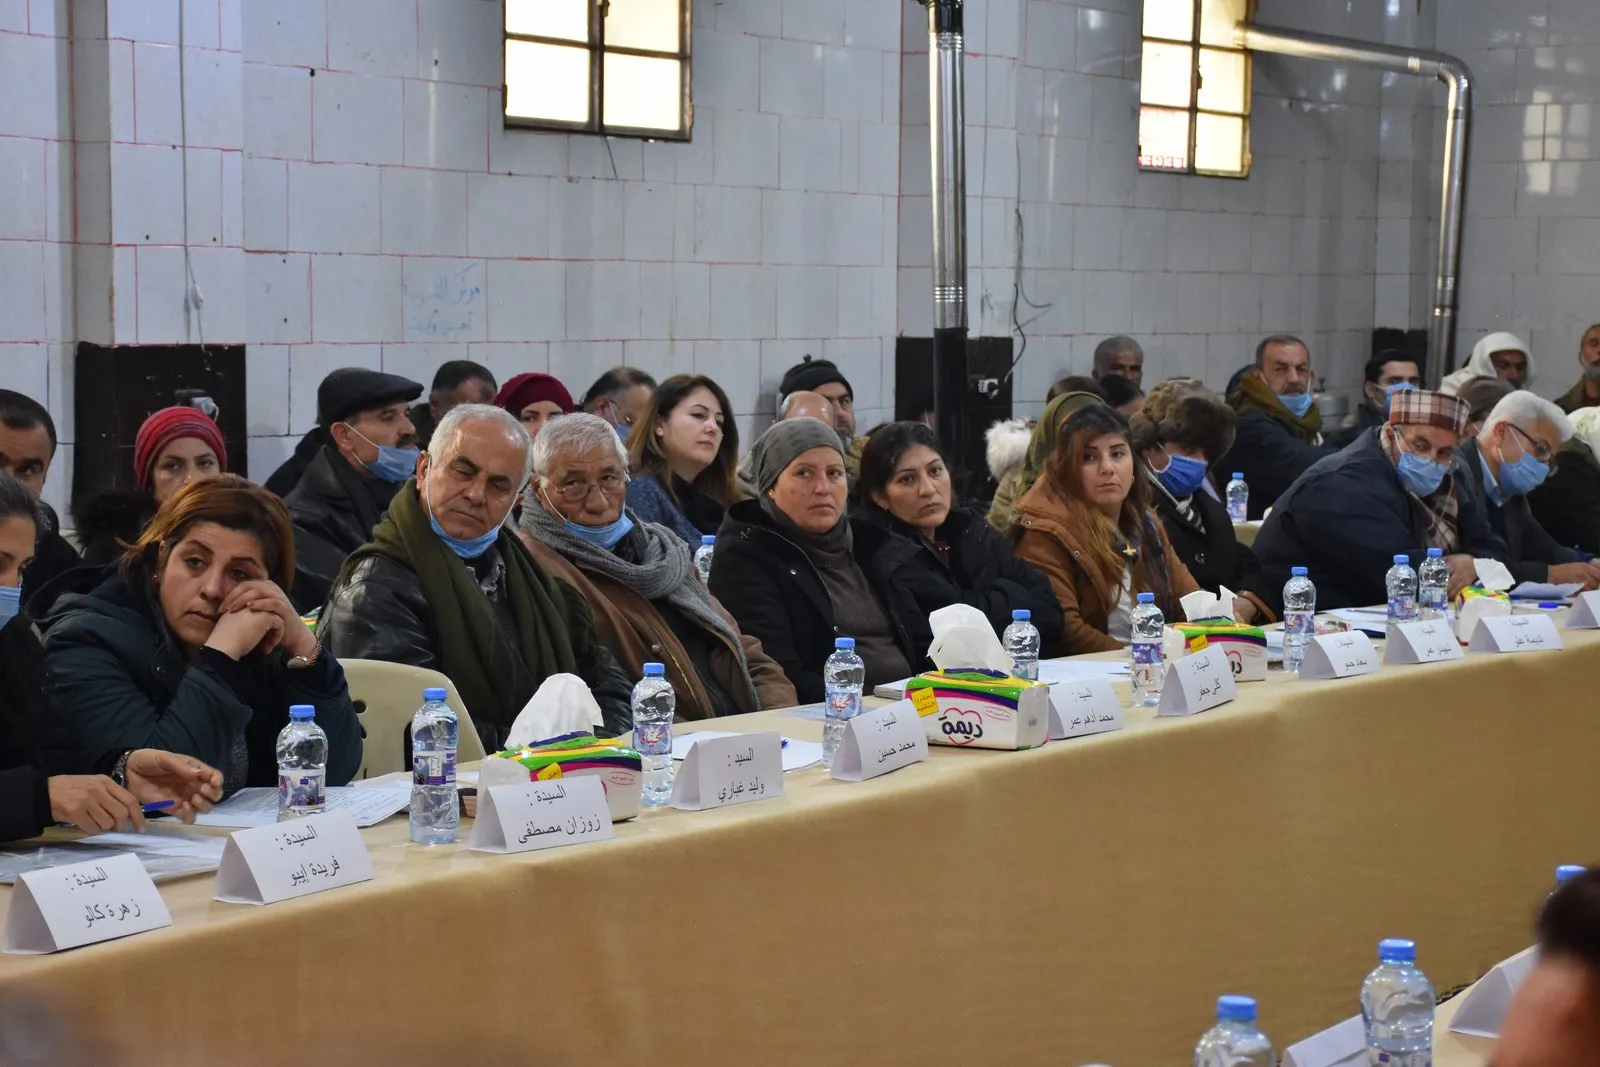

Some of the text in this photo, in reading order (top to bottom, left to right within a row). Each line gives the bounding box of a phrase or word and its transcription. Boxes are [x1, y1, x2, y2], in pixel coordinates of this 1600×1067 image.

[877, 748, 897, 763] حسين
[899, 741, 916, 753] محمد
[748, 776, 765, 795] وليد
[518, 814, 601, 844] زوزان مصطفى
[308, 855, 340, 877] فريدة
[84, 898, 141, 928] زهرة كالو
